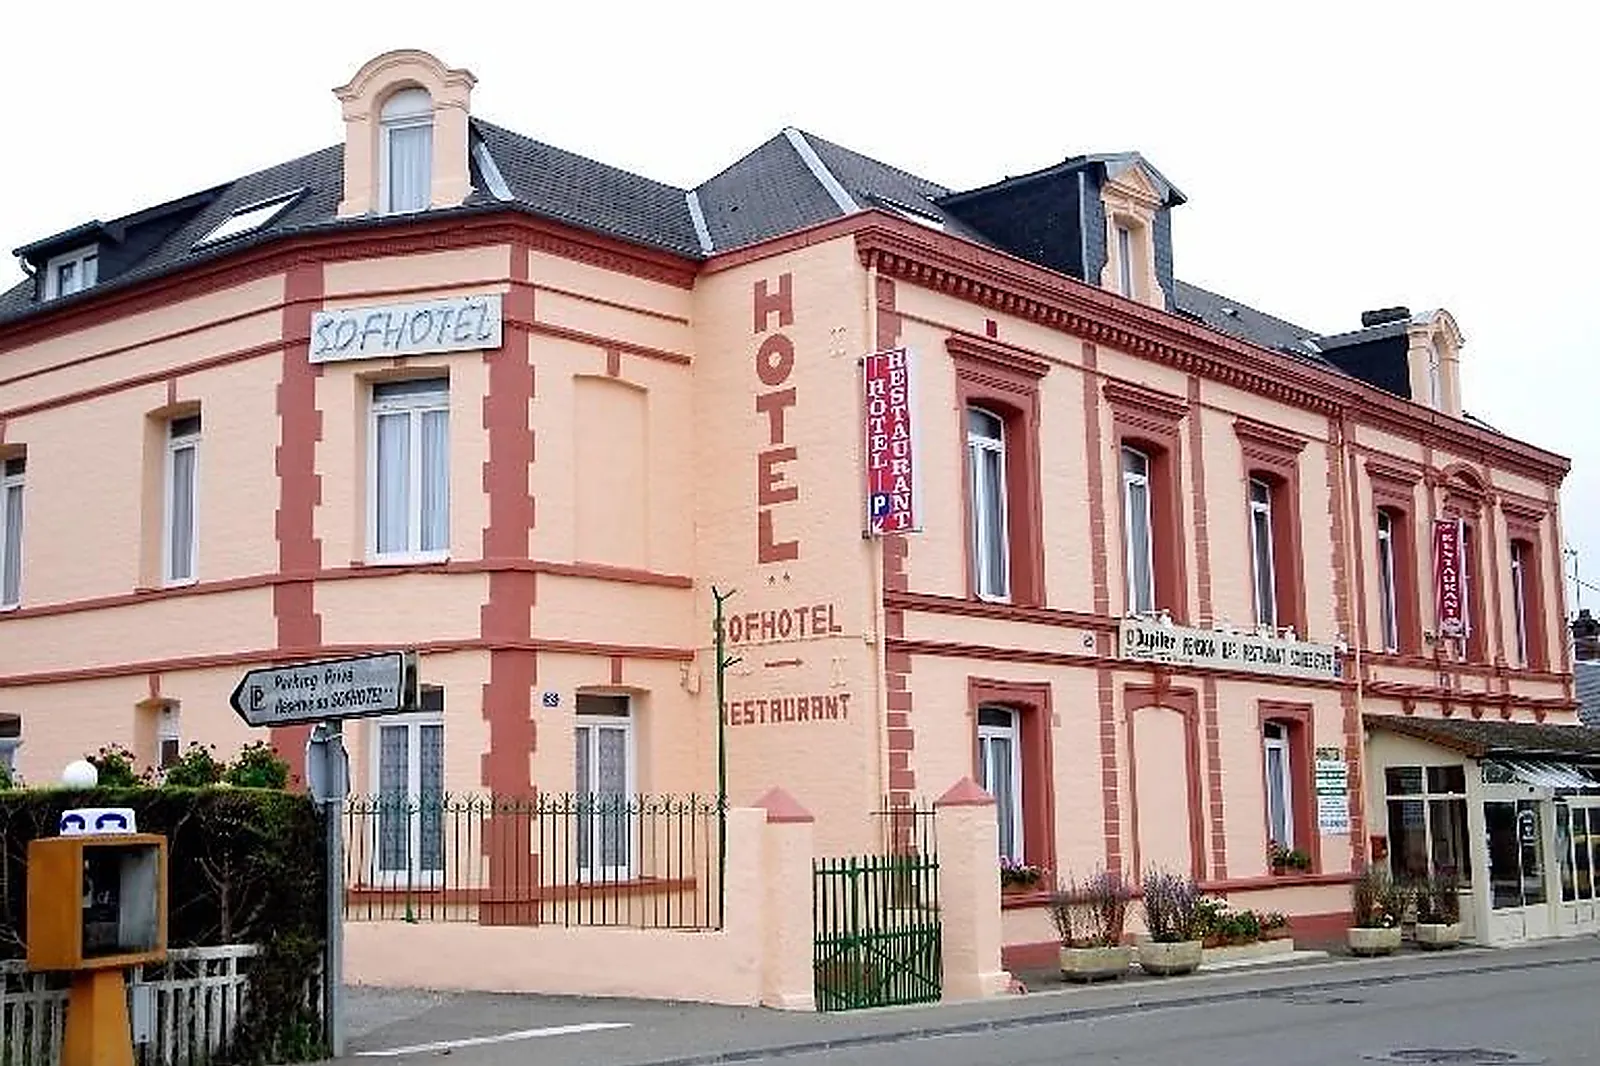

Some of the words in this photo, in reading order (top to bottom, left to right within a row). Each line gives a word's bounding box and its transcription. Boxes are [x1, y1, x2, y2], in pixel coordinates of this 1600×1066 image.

[314, 301, 493, 355] SOFHOTEL
[754, 272, 800, 564] HOTEL
[867, 379, 889, 469] HOTEL
[888, 353, 912, 529] RESTAURANT
[1137, 628, 1176, 650] Jupiler
